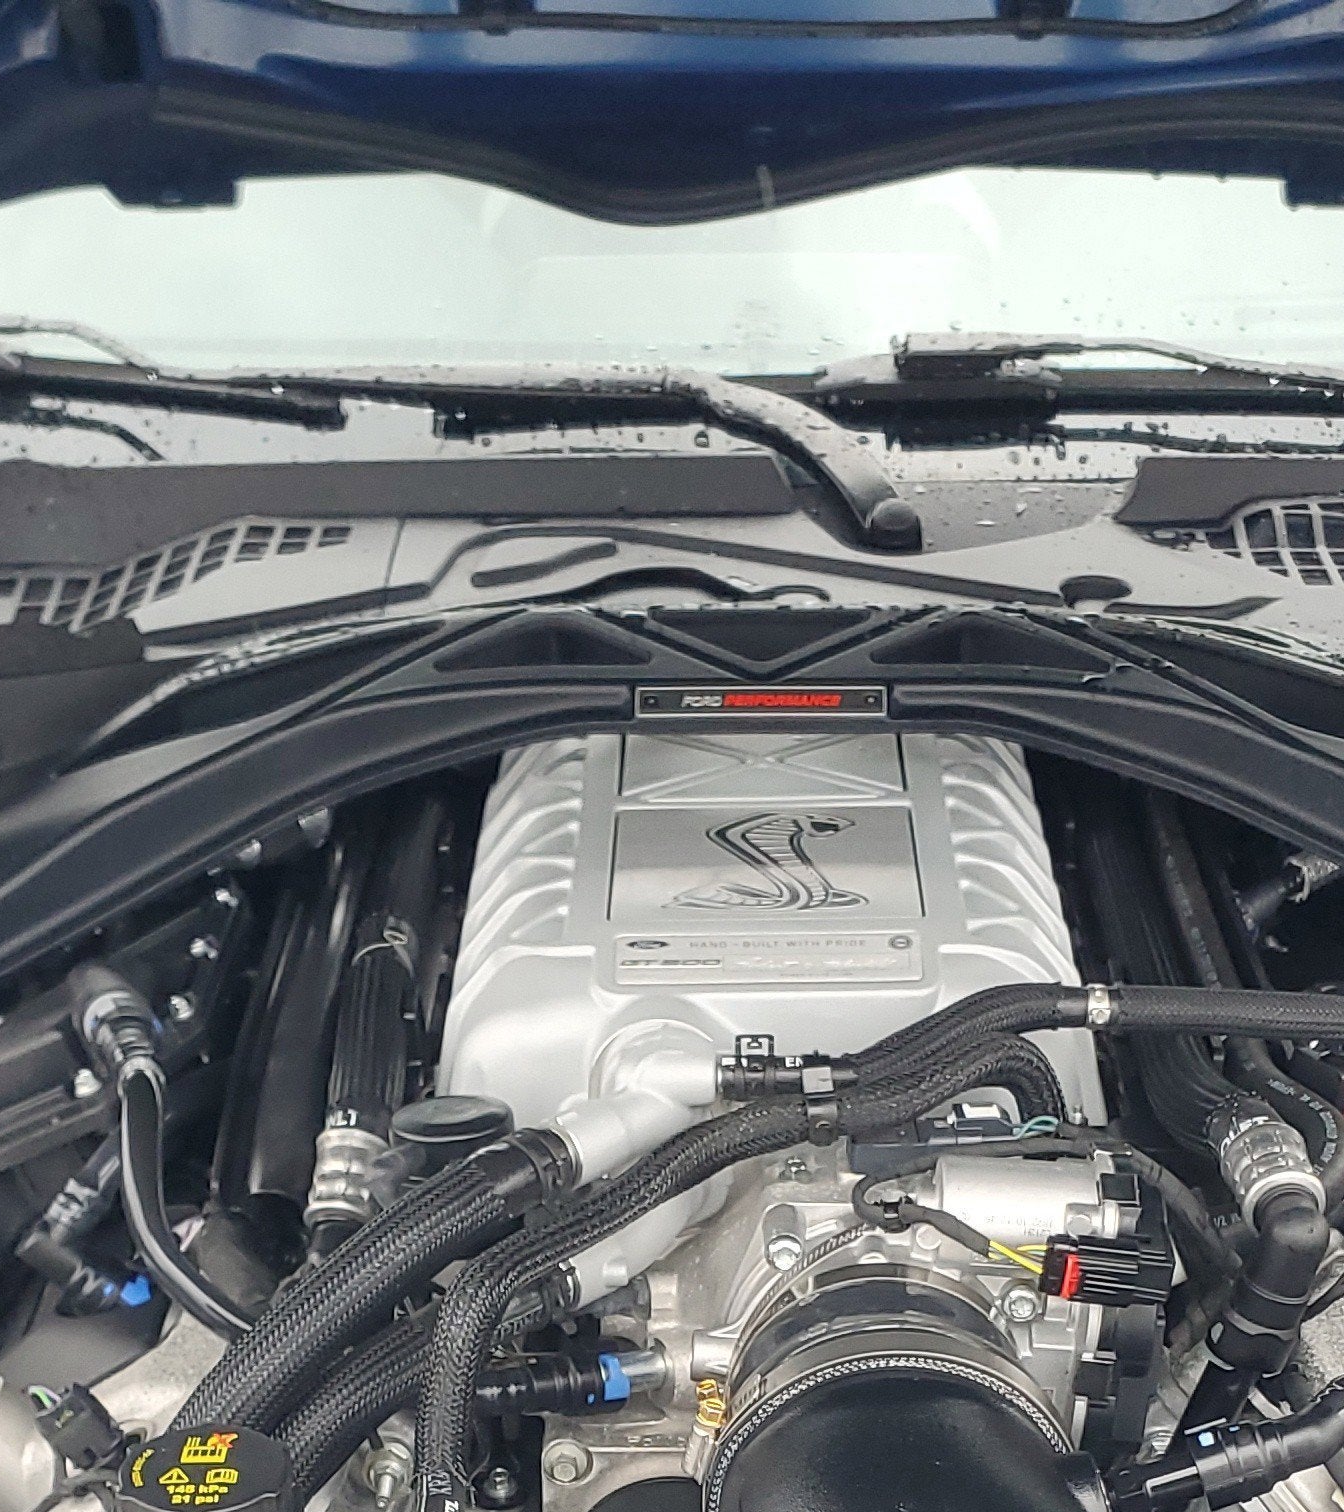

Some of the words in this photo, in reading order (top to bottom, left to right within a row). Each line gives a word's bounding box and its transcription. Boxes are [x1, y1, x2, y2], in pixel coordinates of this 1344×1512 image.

[680, 694, 723, 708] FORD
[723, 693, 842, 708] PERFORMANCE
[689, 941, 728, 949] HAND
[741, 940, 779, 949] BUILT
[786, 940, 820, 948] WITH
[826, 939, 867, 948] PRIDE
